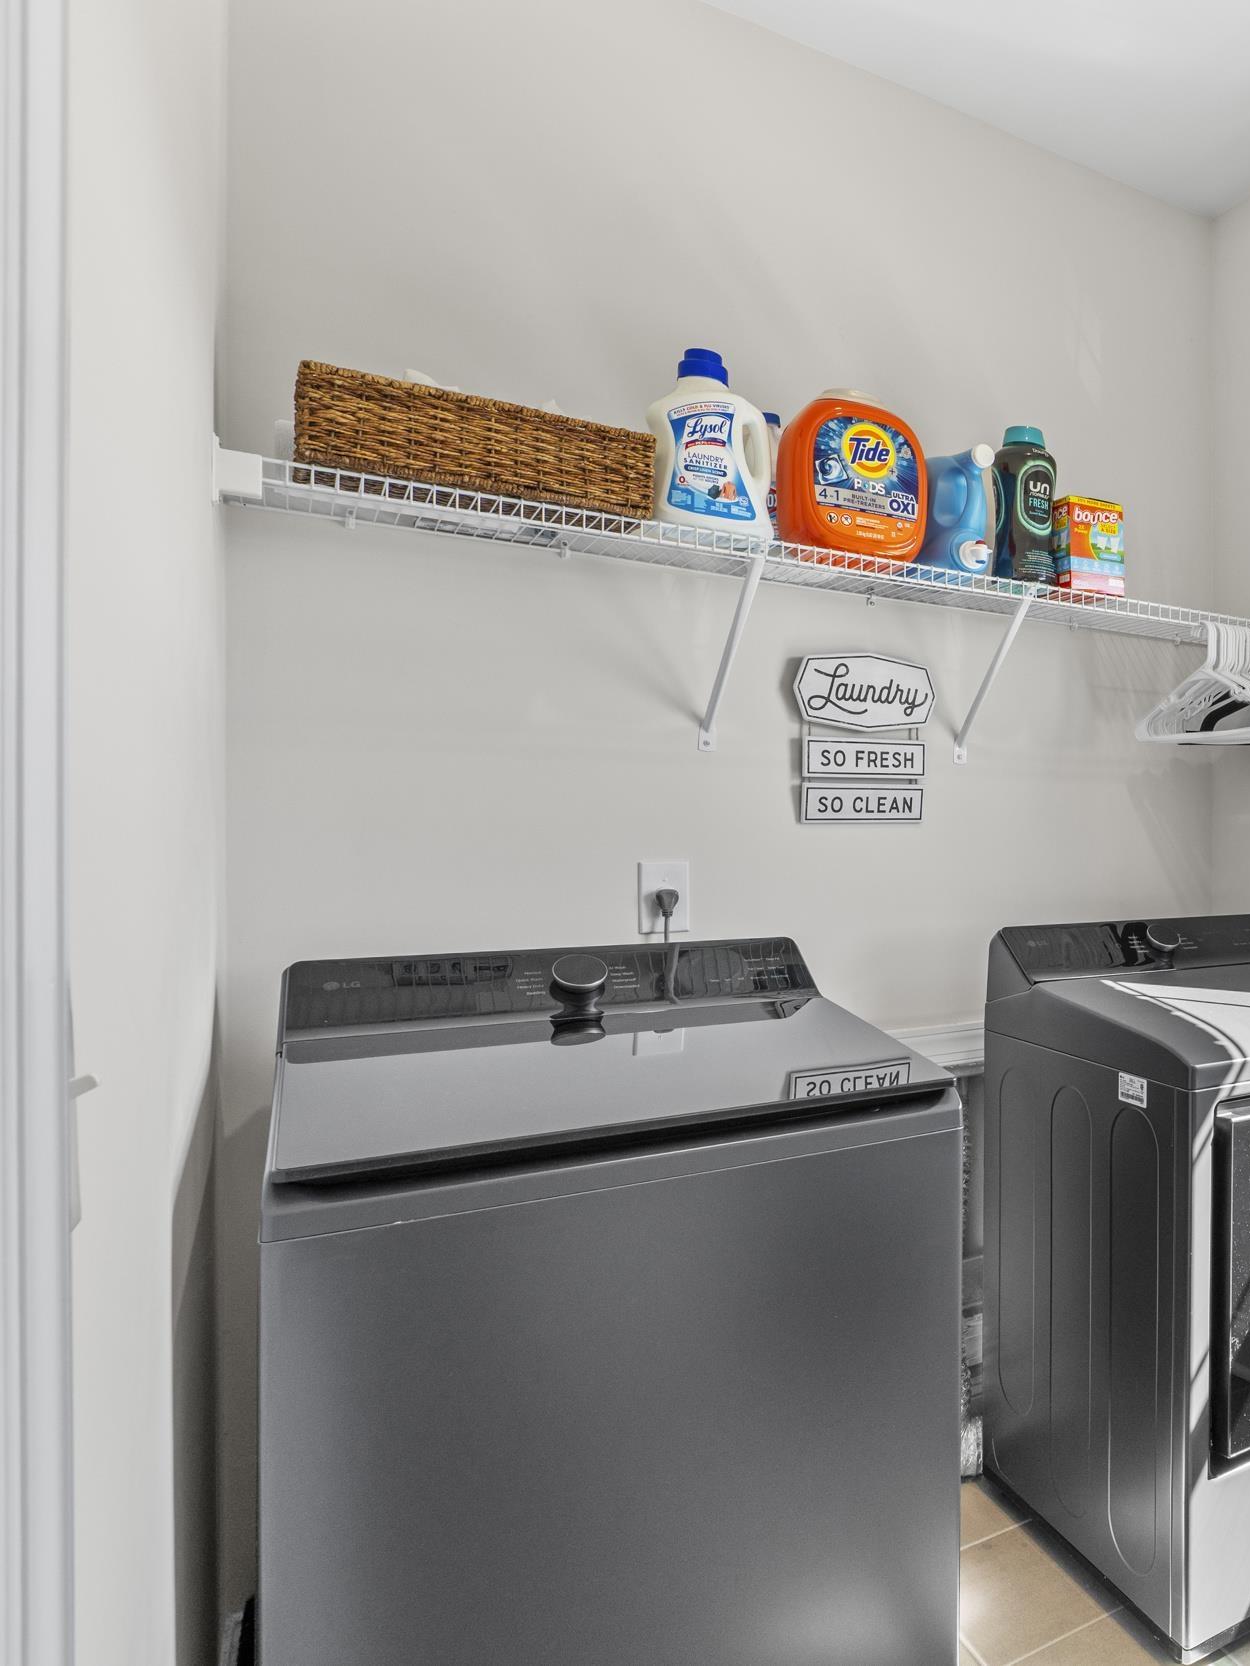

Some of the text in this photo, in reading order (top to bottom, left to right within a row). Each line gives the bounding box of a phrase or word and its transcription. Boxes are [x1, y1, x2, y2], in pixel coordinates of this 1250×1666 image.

[687, 418, 727, 440] Lysol
[687, 451, 724, 464] LAUNDRY
[848, 436, 891, 465] Tide
[683, 457, 728, 470] SANITIZER
[854, 478, 886, 495] PODS
[843, 497, 886, 510] PRE-TREATERS
[892, 491, 915, 503] ULTRA
[1028, 497, 1049, 511] FRESH
[888, 498, 916, 516] OXI
[1074, 507, 1118, 524] bounce
[807, 662, 929, 717] Laundry
[820, 749, 915, 769] SO FRESH
[817, 796, 913, 814] SO CLEAN
[342, 981, 361, 989] LG
